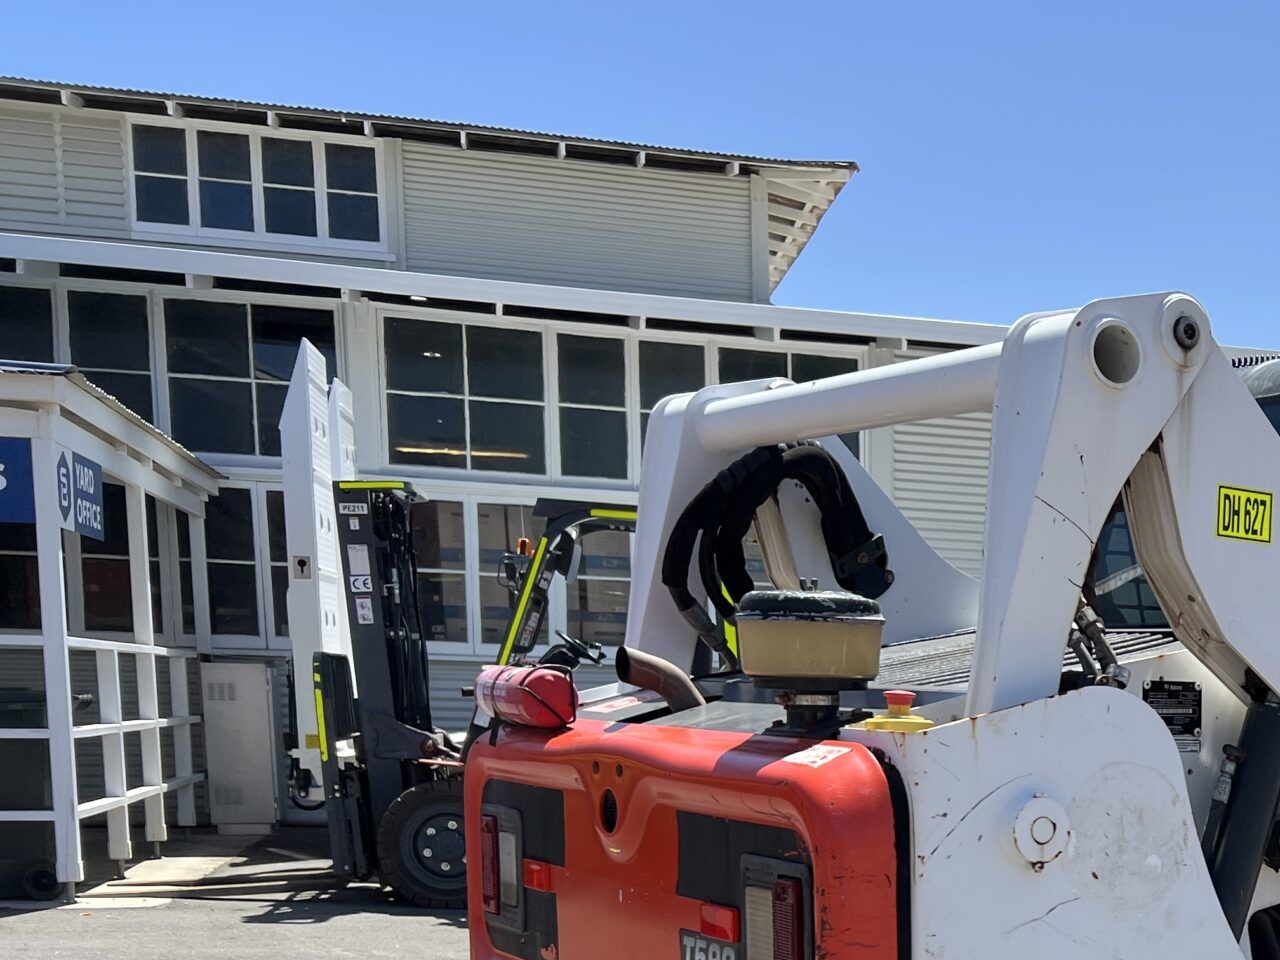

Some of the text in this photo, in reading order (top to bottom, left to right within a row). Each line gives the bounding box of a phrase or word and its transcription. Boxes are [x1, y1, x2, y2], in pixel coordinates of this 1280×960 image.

[75, 462, 94, 494] YARD
[76, 498, 102, 530] OFFICE
[342, 504, 365, 513] PE211
[1223, 493, 1267, 536] DH 627
